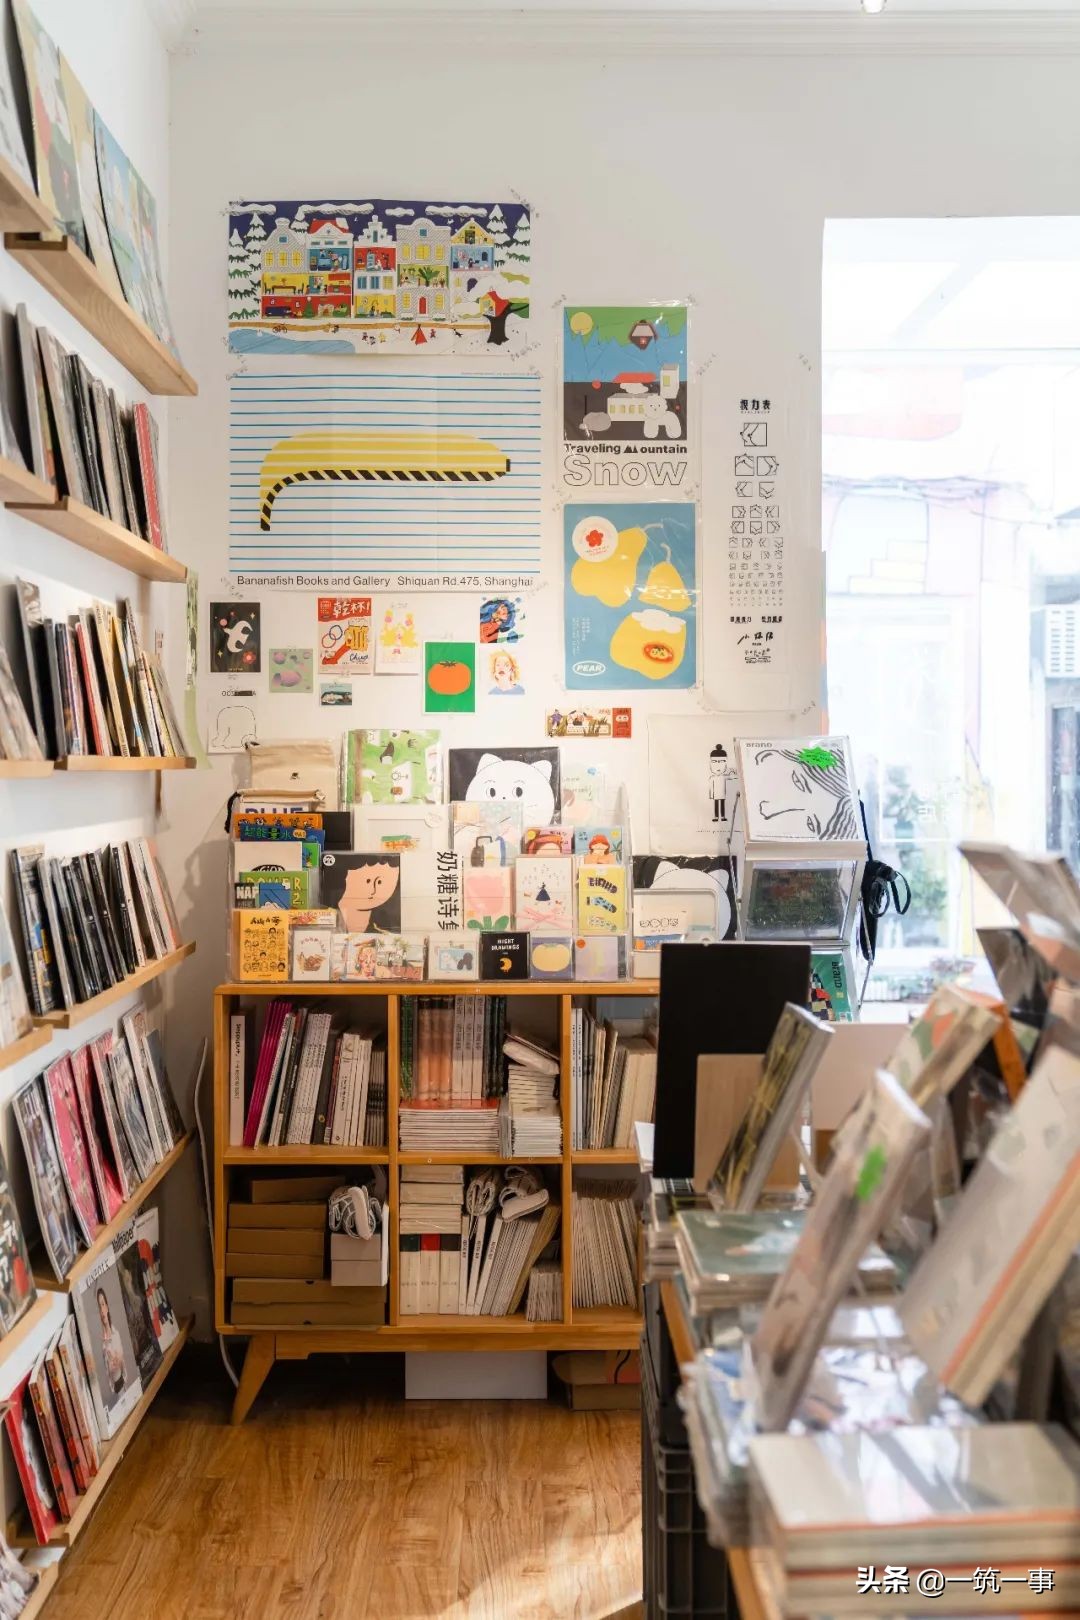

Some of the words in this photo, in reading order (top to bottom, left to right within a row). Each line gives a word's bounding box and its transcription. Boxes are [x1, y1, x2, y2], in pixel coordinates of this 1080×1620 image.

[564, 443, 621, 455] Traveling
[563, 453, 688, 487] Snow
[237, 575, 294, 586] Bananafish
[296, 575, 329, 586] Books
[331, 575, 350, 586] and
[352, 575, 391, 588] Gallery
[397, 576, 440, 588] Shiquan
[484, 576, 534, 588] Shanghai
[576, 664, 602, 672] PEAR
